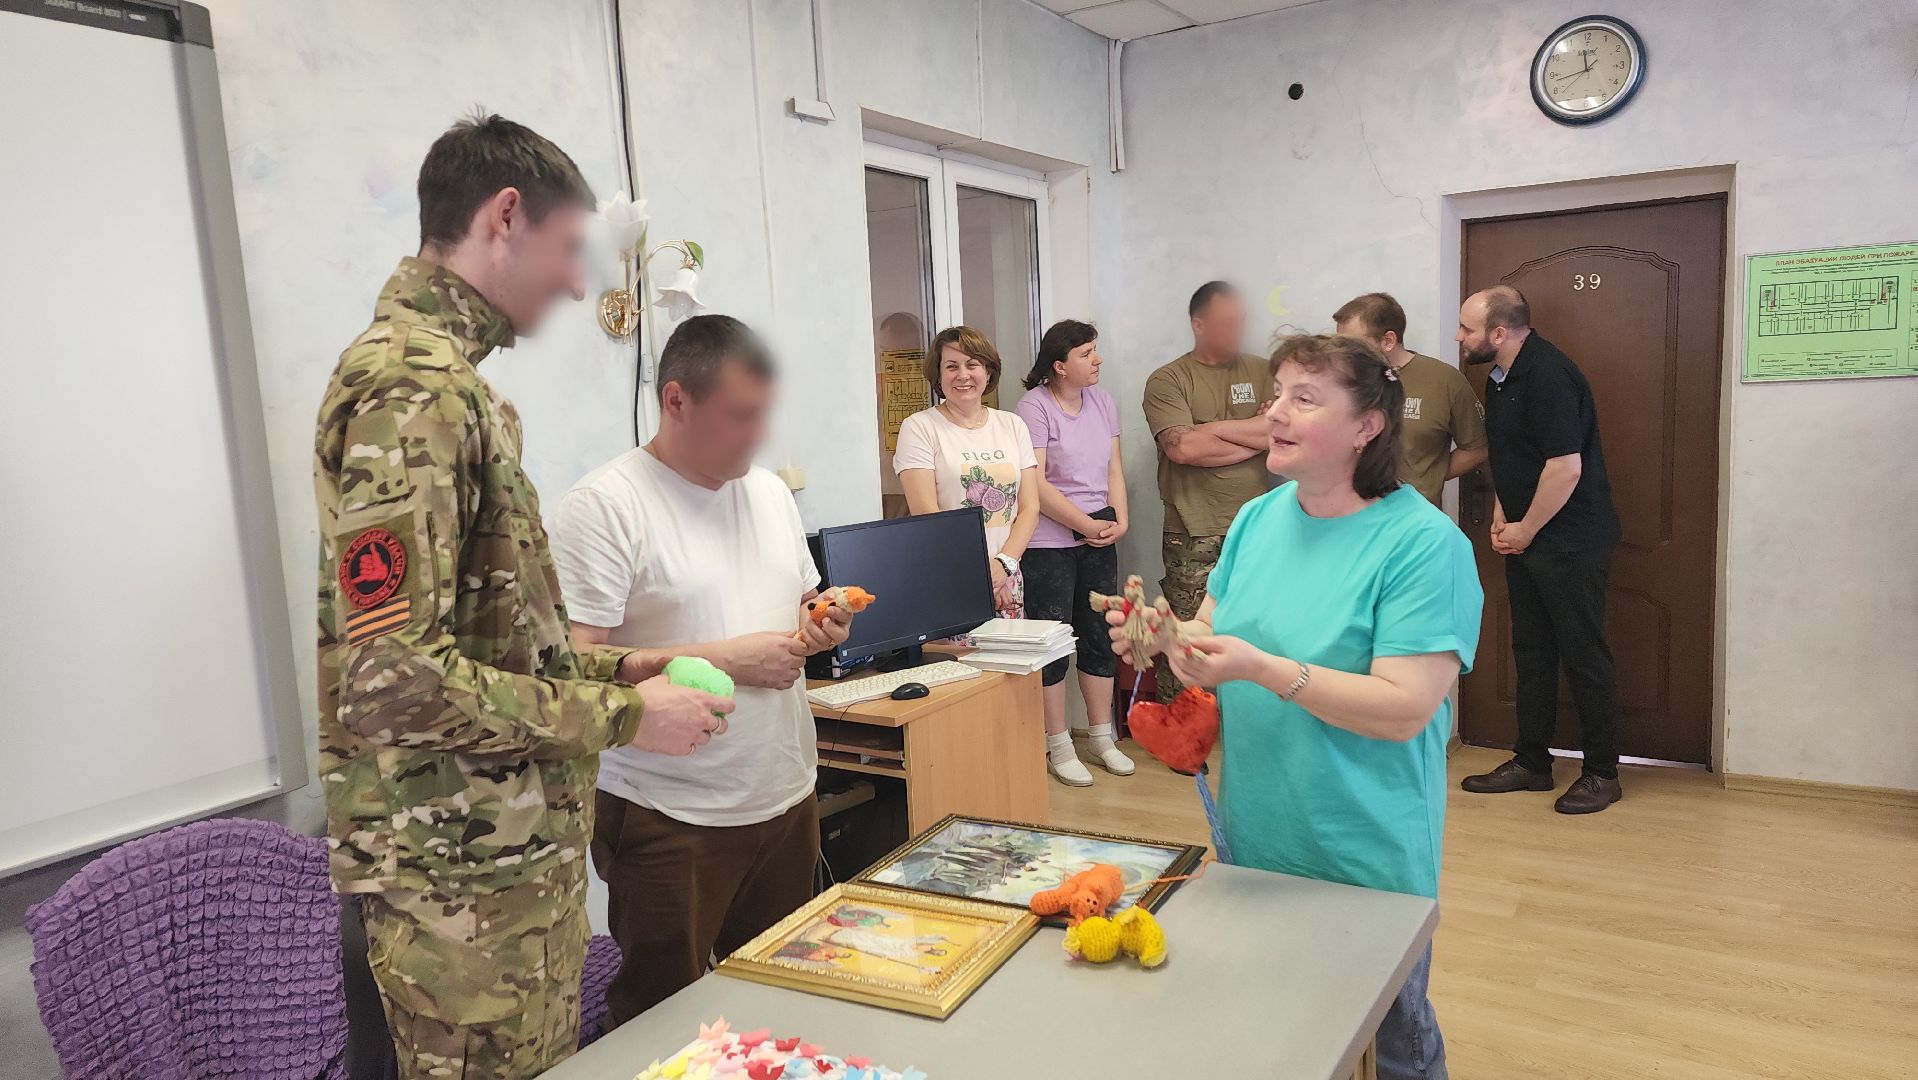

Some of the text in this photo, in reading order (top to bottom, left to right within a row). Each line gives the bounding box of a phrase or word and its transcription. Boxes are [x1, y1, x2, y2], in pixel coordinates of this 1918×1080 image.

[1584, 33, 1592, 41] 12
[1615, 45, 1621, 53] 2
[1551, 54, 1560, 63] 10
[1618, 61, 1625, 70] 3
[1550, 71, 1555, 80] 9
[1612, 78, 1619, 86] 4
[1601, 93, 1606, 102] 5
[1839, 253, 1866, 261] ЛЮДЕЙ
[1883, 250, 1915, 258] ПОЖАРЕ
[1573, 273, 1601, 291] 39
[961, 450, 1004, 461] FIGO
